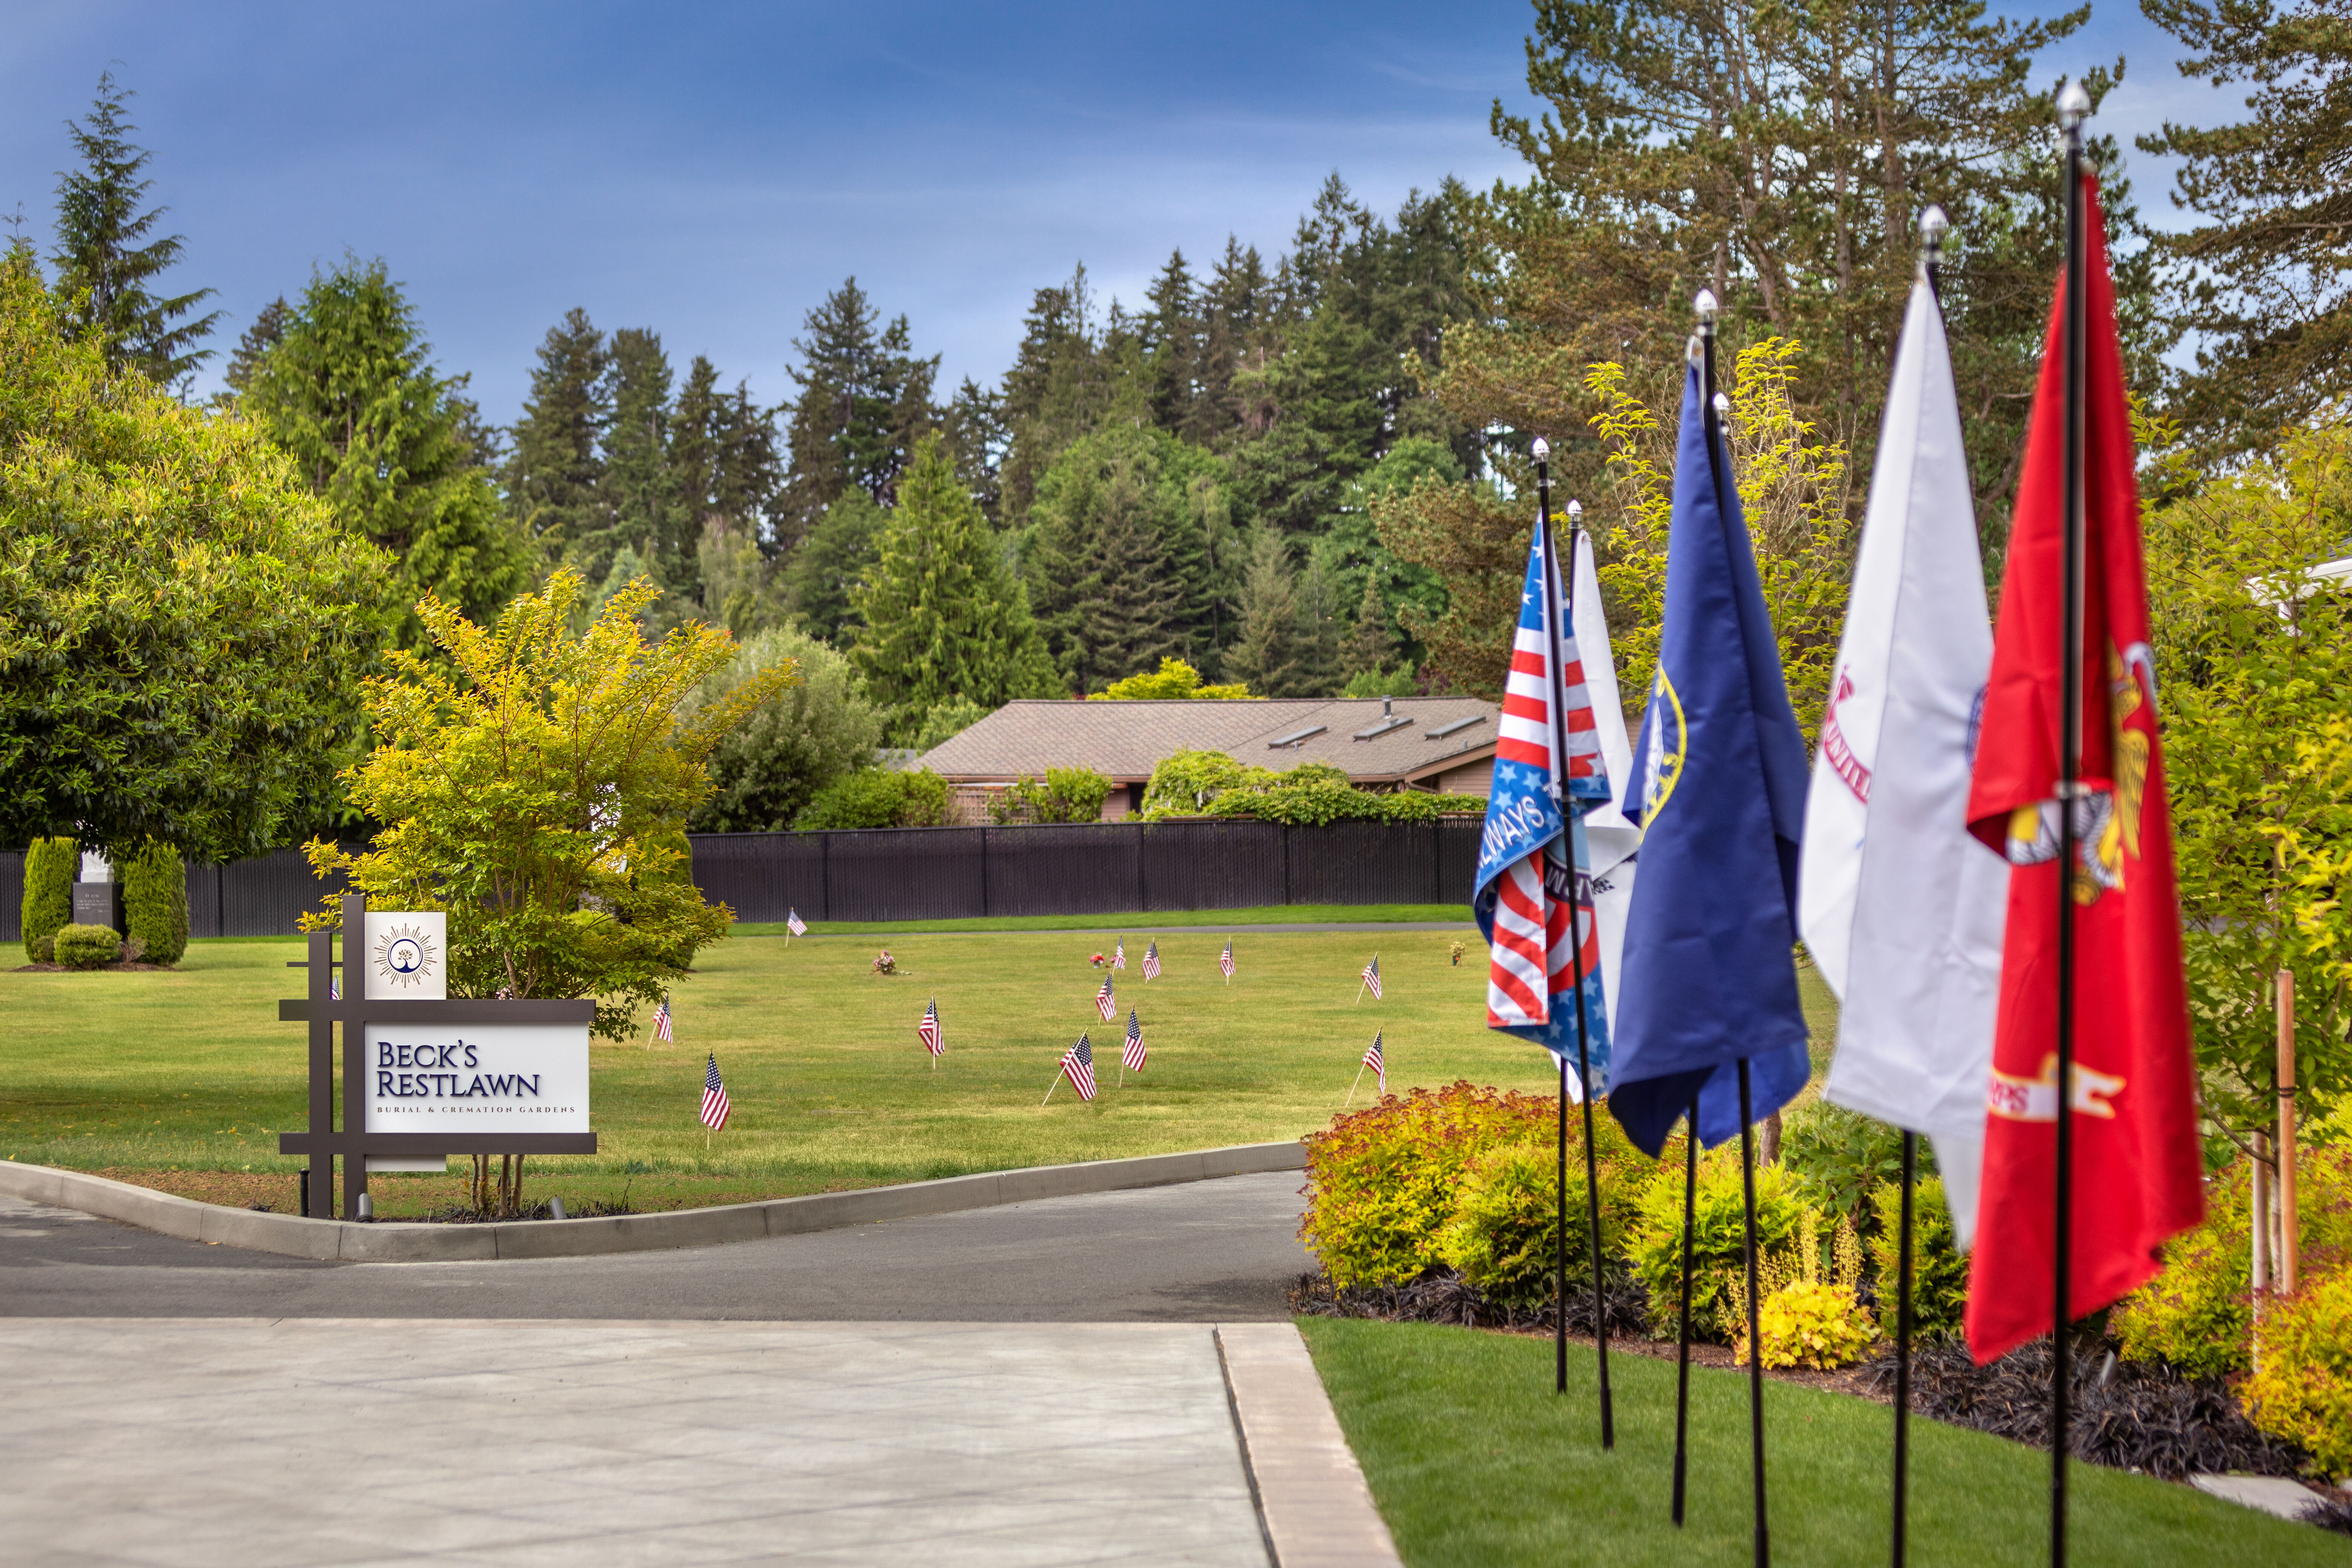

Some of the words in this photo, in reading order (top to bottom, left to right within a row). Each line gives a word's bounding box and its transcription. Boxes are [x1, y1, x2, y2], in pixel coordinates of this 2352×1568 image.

[1479, 795, 1545, 869] LWAYS
[377, 1039, 478, 1068] BECK'S
[376, 1071, 540, 1097] RESTLAWN
